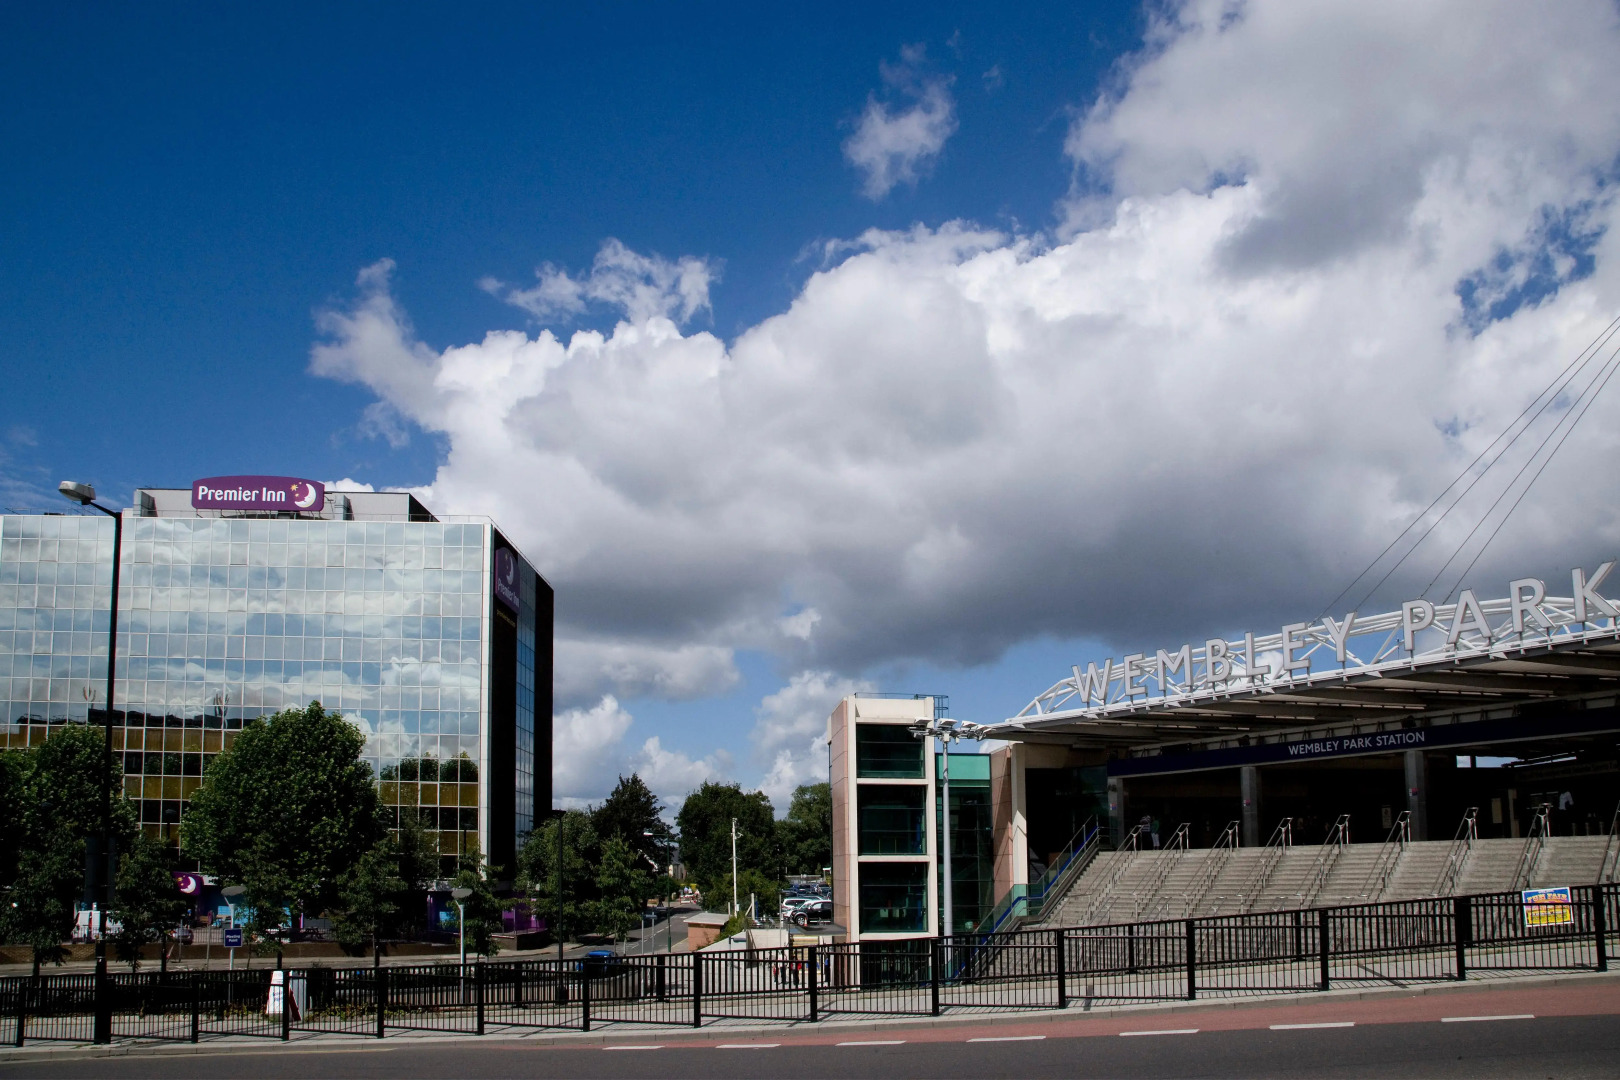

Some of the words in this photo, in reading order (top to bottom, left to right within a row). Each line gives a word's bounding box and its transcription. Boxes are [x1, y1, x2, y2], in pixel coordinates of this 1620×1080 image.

[198, 486, 259, 501] Premier
[262, 487, 286, 502] Inn
[1071, 612, 1358, 703] WEMBLEY
[1402, 560, 1620, 651] PARK
[1288, 741, 1339, 755] WEMBLEY
[1343, 737, 1372, 749] PARK
[1376, 731, 1425, 746] STATION
